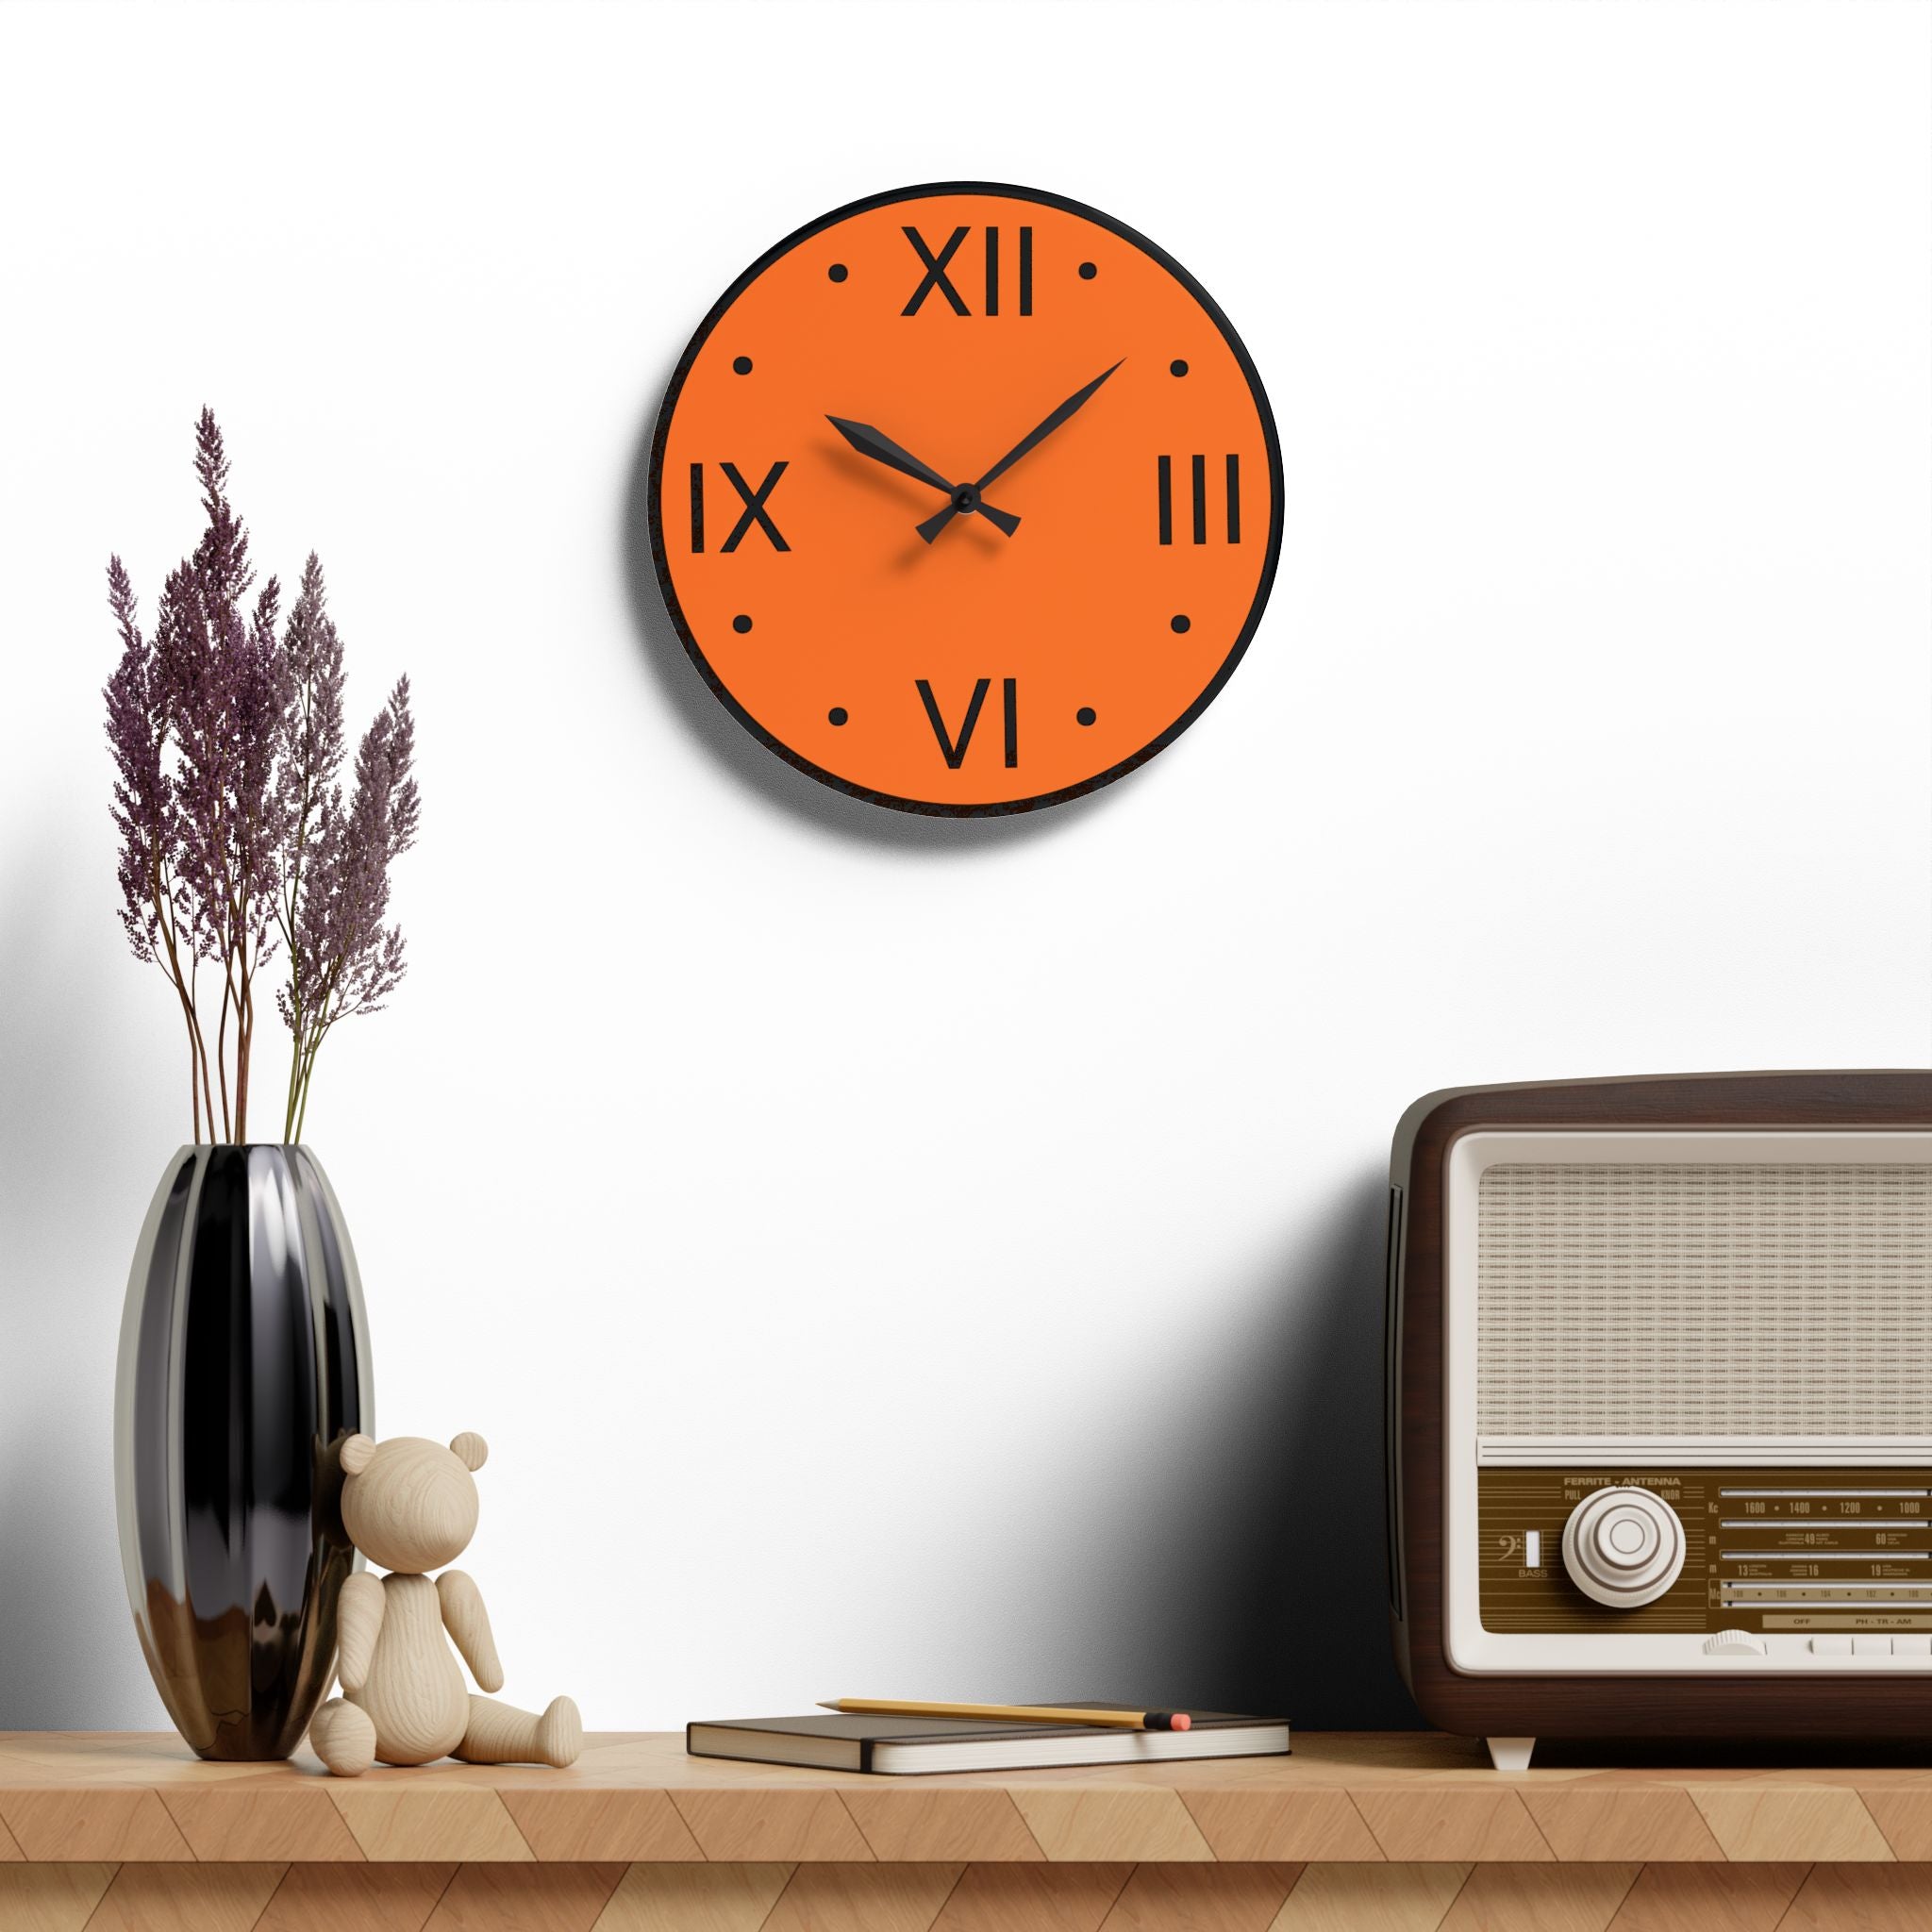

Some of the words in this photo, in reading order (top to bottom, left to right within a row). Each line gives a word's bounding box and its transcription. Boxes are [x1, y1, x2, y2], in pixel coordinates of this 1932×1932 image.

[901, 226, 1032, 316] XII
[1158, 454, 1241, 545] III
[691, 461, 791, 553] IX
[914, 678, 1018, 769] VI
[1564, 1477, 1611, 1486] FERRITE
[1623, 1477, 1681, 1486] ANTENNA
[1564, 1490, 1581, 1500] PULL
[1745, 1502, 1766, 1514] 1600
[1790, 1502, 1810, 1514] 1400
[1840, 1502, 1860, 1514] 1200
[1900, 1502, 1921, 1514] 1000
[1805, 1533, 1815, 1545] 49
[1875, 1533, 1887, 1545] 60
[1518, 1569, 1548, 1578] BASS
[1738, 1564, 1749, 1576] 13
[1808, 1564, 1819, 1576] 16
[1871, 1564, 1881, 1576] 19
